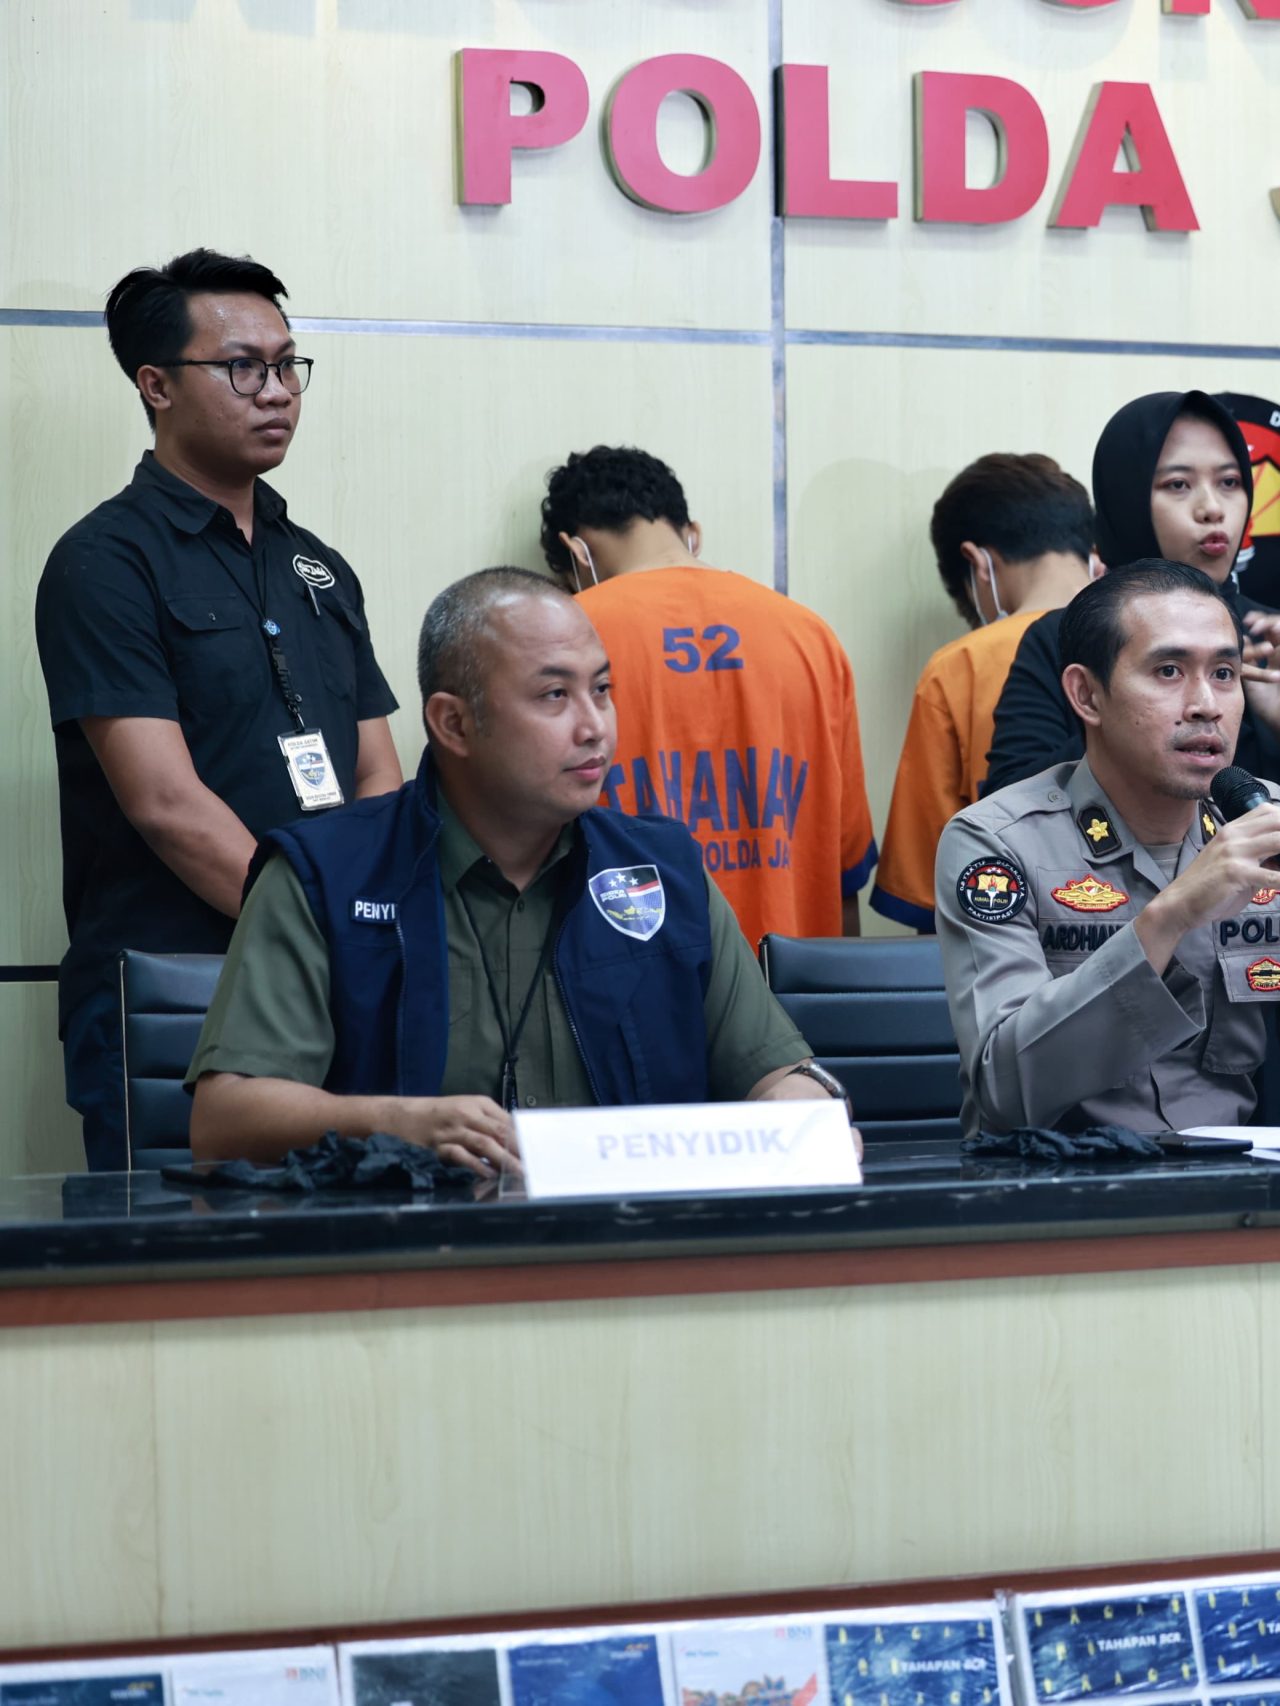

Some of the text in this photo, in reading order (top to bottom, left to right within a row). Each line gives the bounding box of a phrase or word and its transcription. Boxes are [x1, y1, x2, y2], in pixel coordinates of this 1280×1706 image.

[454, 48, 1201, 232] POLDA
[663, 624, 743, 673] 52
[700, 839, 761, 872] OLDA
[355, 900, 396, 920] PENYI
[596, 1128, 790, 1160] PENYIDIK
[1097, 1632, 1181, 1651] TAHAPAN BCA
[901, 1659, 961, 1673] TAHAPAN
